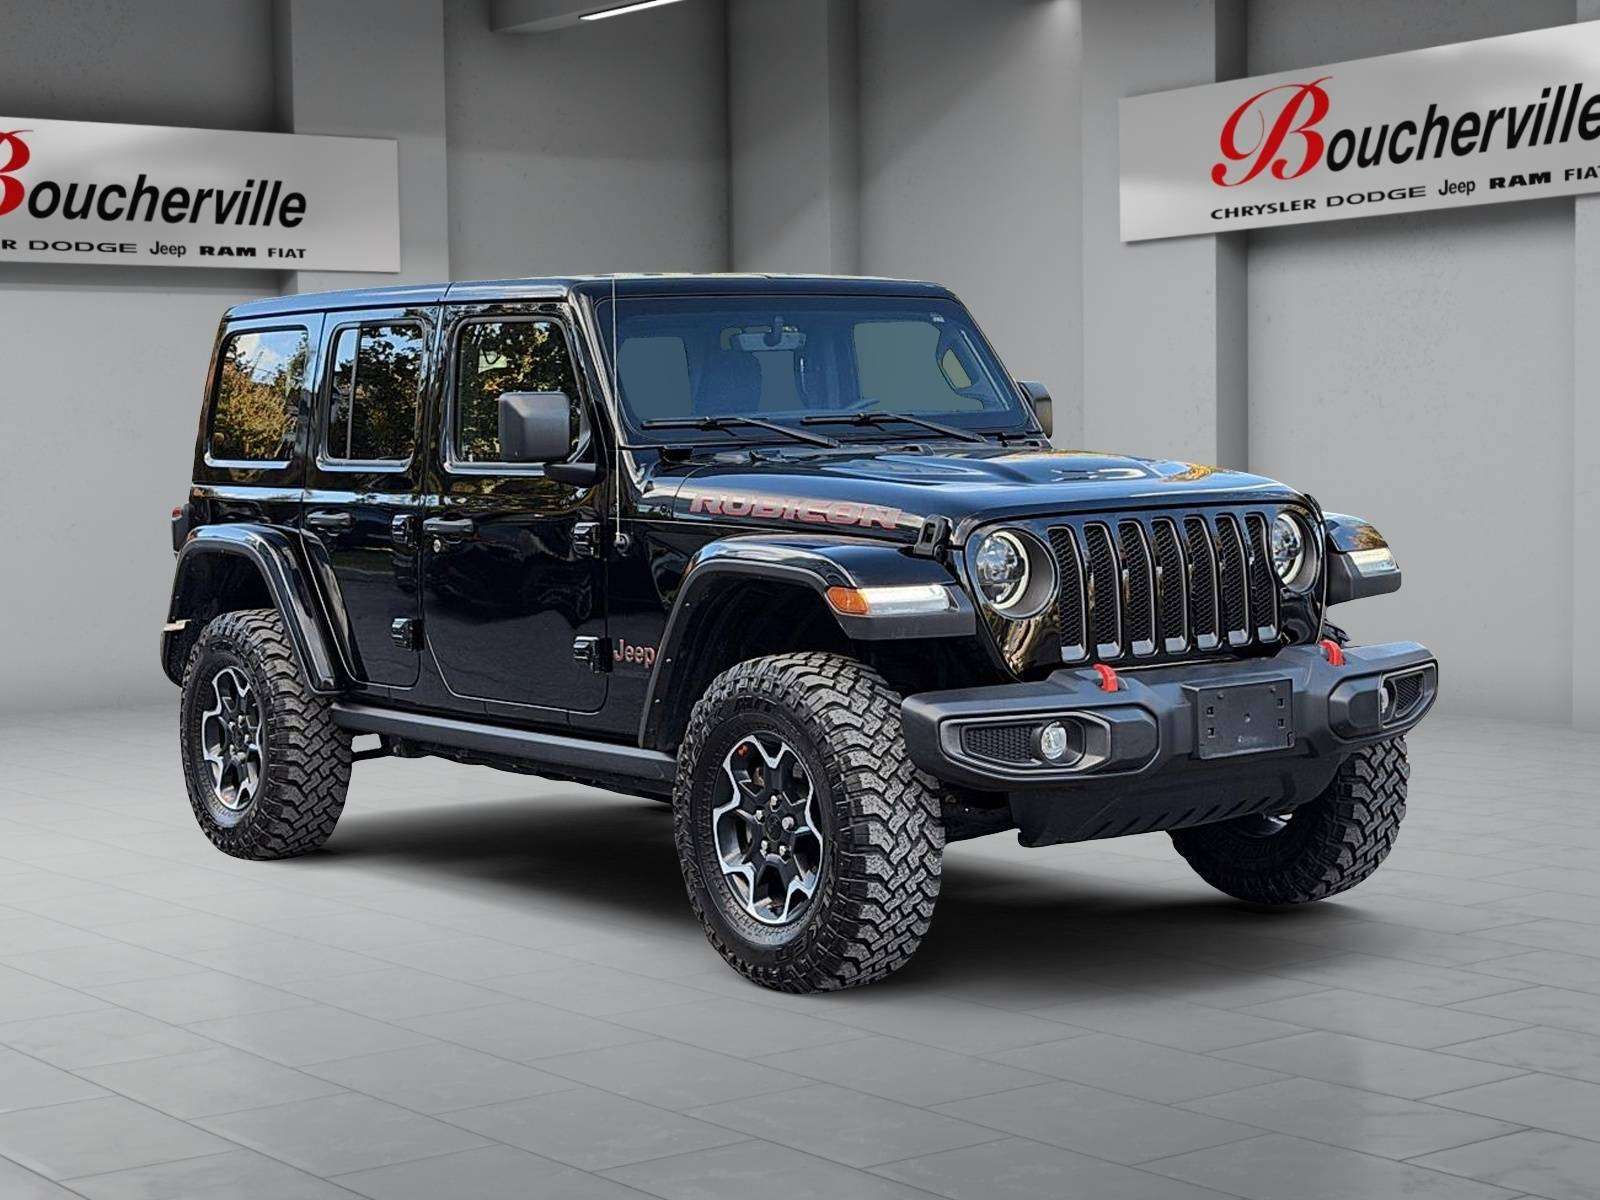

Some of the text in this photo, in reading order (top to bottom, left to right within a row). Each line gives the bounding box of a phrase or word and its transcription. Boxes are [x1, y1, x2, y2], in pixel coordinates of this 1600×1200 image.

[1210, 77, 1600, 188] Boucherville
[1210, 198, 1316, 220] CHRYSLER
[1326, 185, 1426, 208] DODGE
[1438, 178, 1476, 196] Jeep
[1489, 171, 1552, 190] RAM
[28, 240, 138, 254] DODGE
[149, 240, 187, 258] Jeep
[199, 245, 257, 257] RAM
[267, 247, 307, 259] FIAT
[688, 494, 902, 530] RUBICON
[612, 638, 656, 669] Jeep
